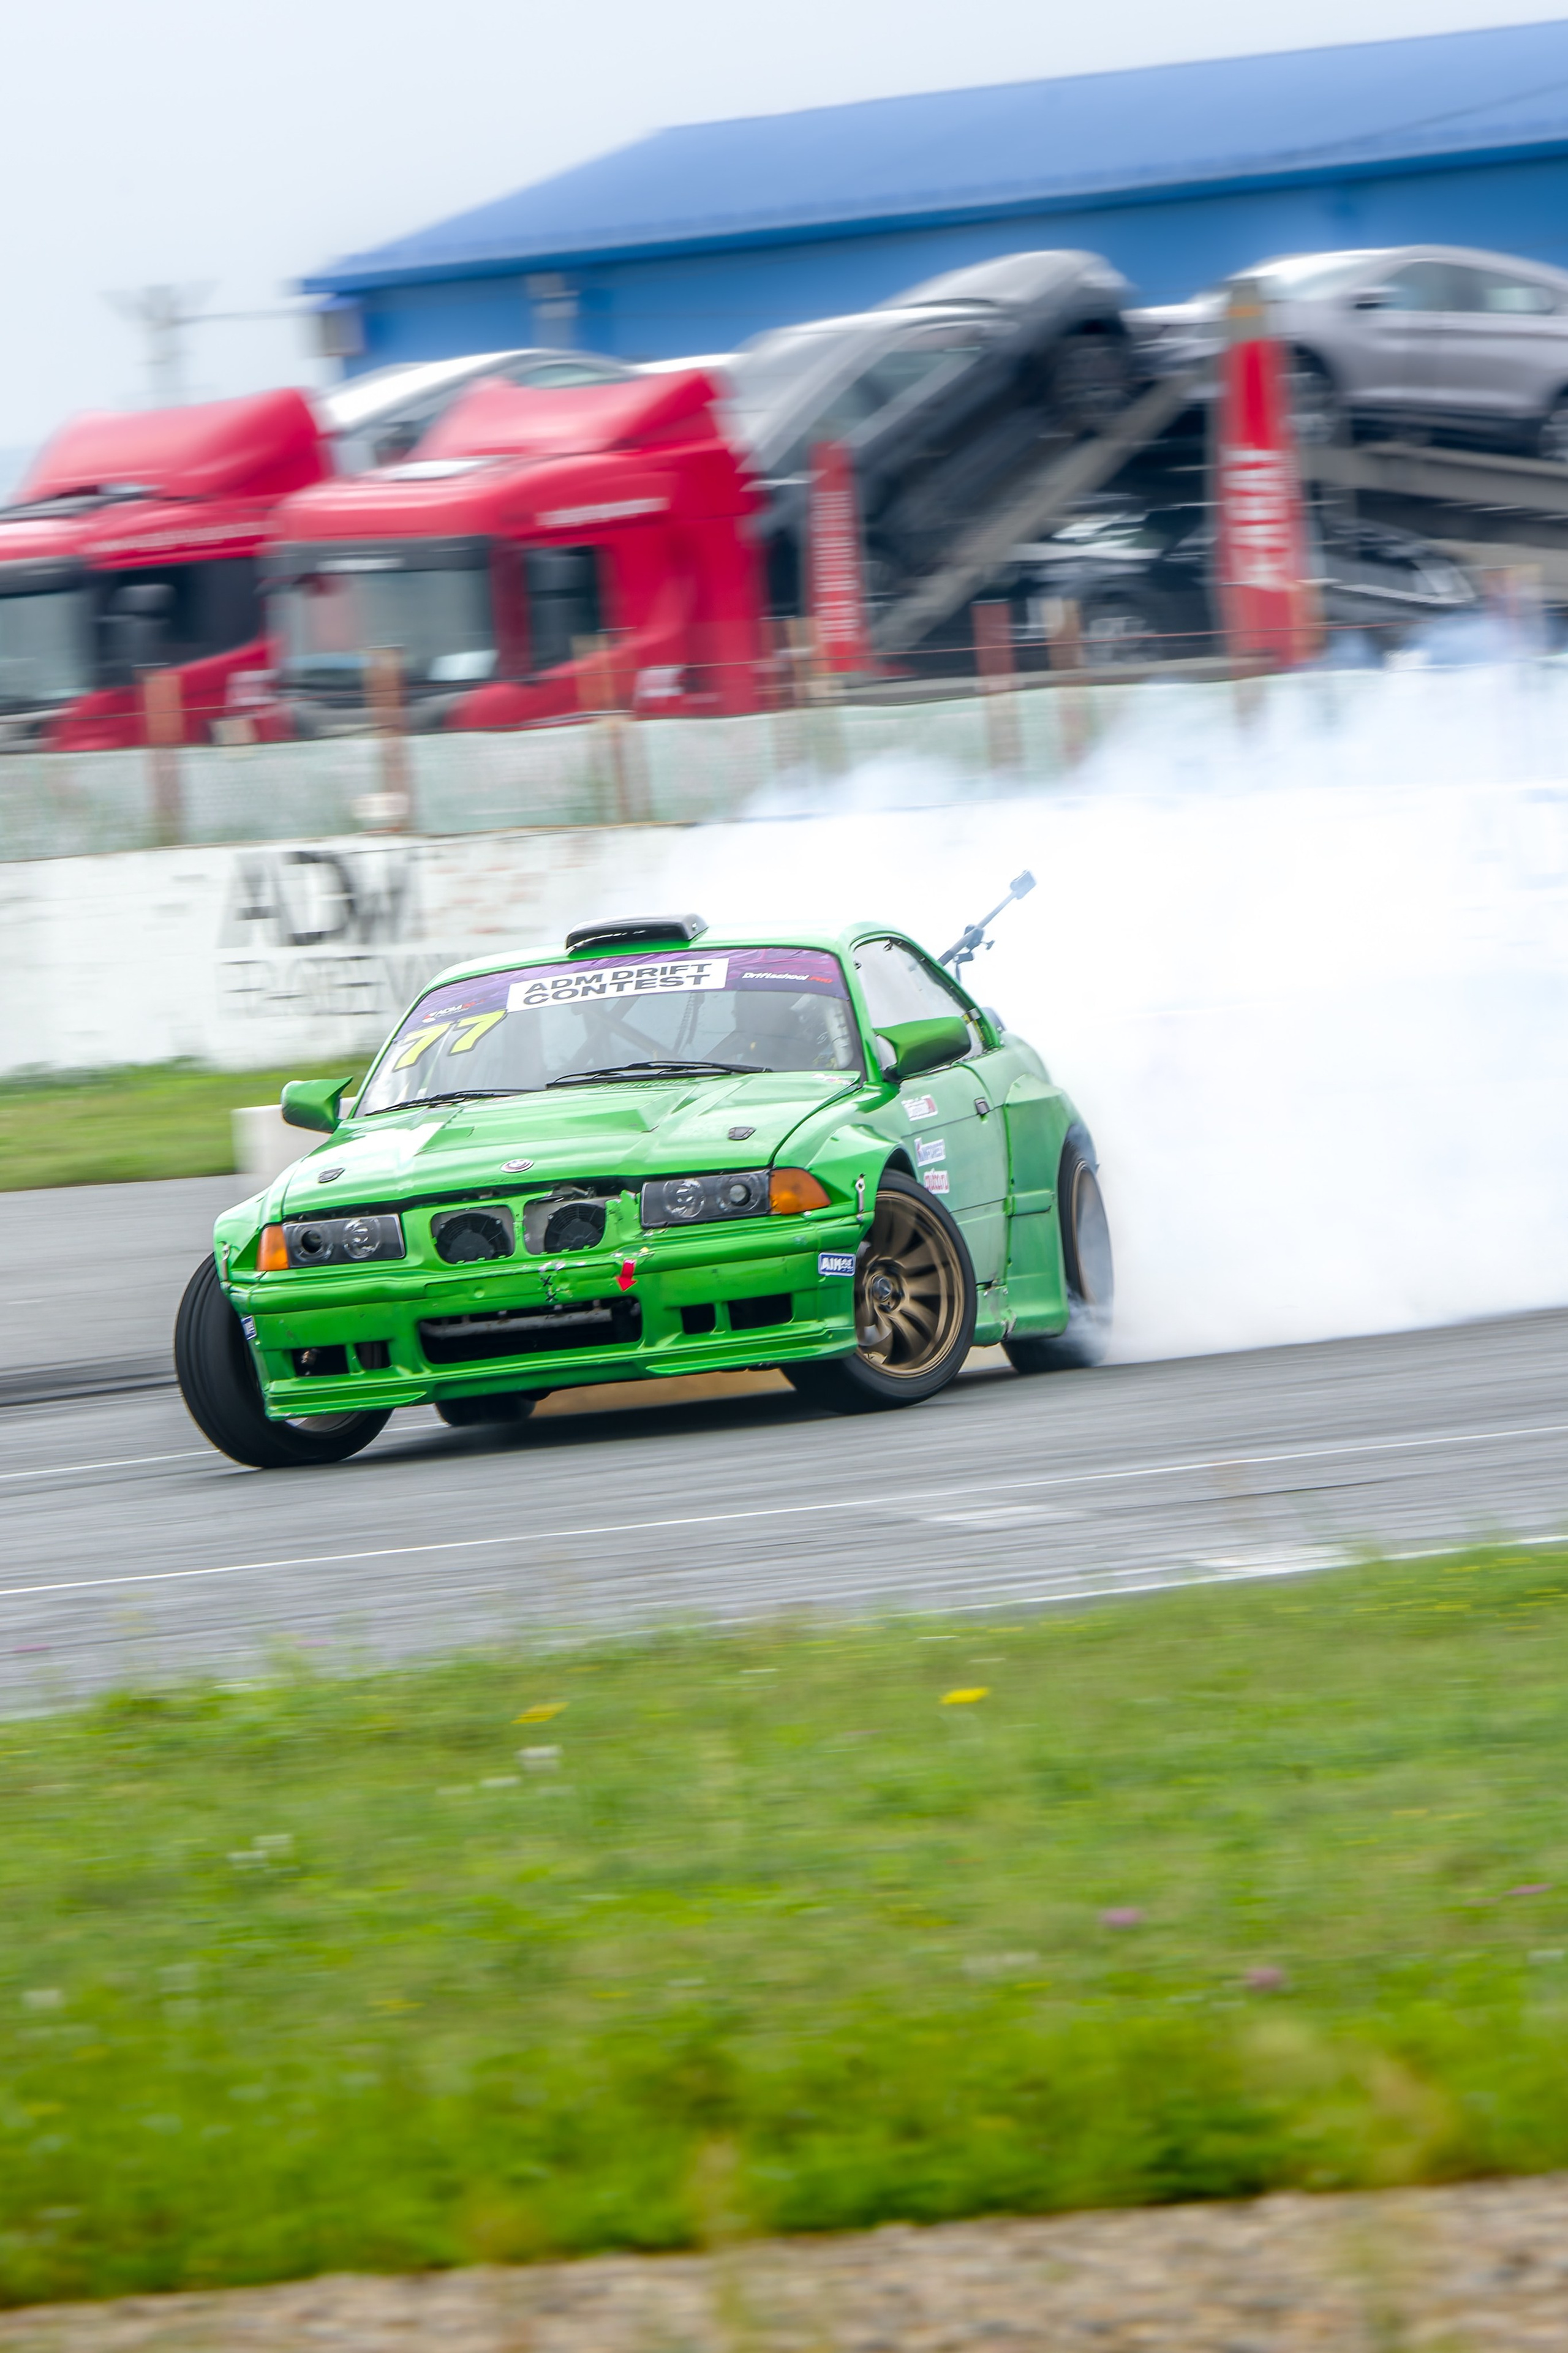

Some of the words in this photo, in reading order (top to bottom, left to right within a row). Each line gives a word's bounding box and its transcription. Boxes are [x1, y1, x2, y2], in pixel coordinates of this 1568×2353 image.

[522, 974, 710, 1006] CONTEST
[525, 973, 603, 994] ADM
[612, 963, 712, 980] DRIFT
[393, 1010, 507, 1072] 77
